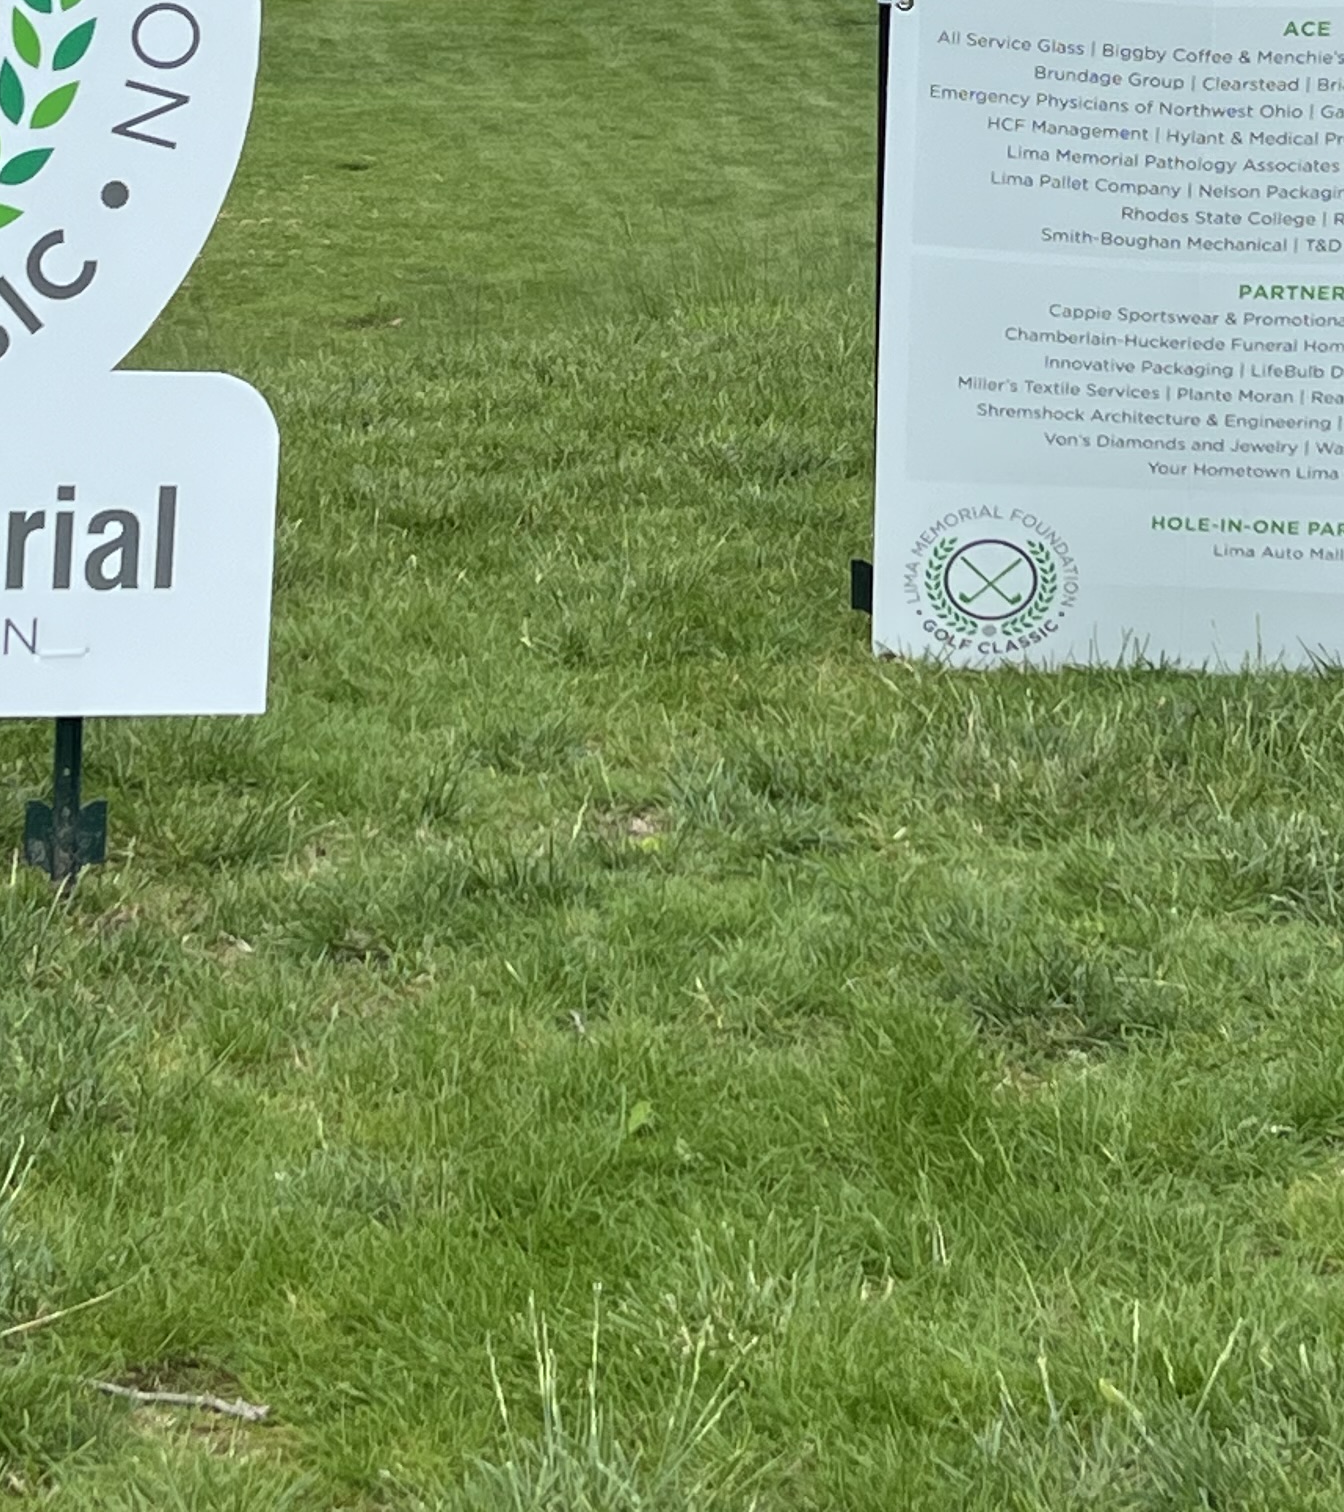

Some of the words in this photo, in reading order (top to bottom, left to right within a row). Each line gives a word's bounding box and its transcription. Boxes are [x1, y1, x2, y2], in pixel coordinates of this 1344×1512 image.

[1282, 20, 1331, 37] ACE
[936, 29, 961, 45] All
[966, 31, 1032, 52] Service
[1036, 38, 1085, 56] Glass
[1101, 42, 1167, 64] Biggby
[1172, 47, 1233, 65] Coffee
[1237, 49, 1252, 65] &
[929, 83, 1031, 109] Emergency
[1035, 91, 1130, 113] Physicians
[1134, 99, 1154, 115] of
[1158, 100, 1254, 119] Northwest
[1258, 103, 1304, 119] Ohio
[1006, 144, 1050, 162] Lima
[1055, 148, 1139, 168] Memorial
[1144, 153, 1238, 175] Pathology
[1242, 157, 1340, 174] Associates
[1120, 205, 1190, 224] Rhodes
[1194, 210, 1243, 226] State
[1246, 210, 1317, 229] College
[1040, 226, 1181, 251] Smith-Boughan
[1186, 235, 1288, 252] Mechanical
[1305, 237, 1343, 253] T&D
[1116, 306, 1220, 326] Sportswear
[1224, 311, 1238, 326] &
[1044, 355, 1136, 374] Innovative
[1140, 359, 1234, 380] Packaging
[1250, 363, 1325, 379] LifeBulb
[1147, 460, 1188, 476] Your
[1192, 462, 1291, 479] Hometown
[1295, 466, 1340, 481] Lima
[1150, 515, 1300, 536] HOLE-IN-ONE
[904, 561, 920, 604] LIMA
[912, 504, 1004, 557] MEMORIAL
[1009, 508, 1079, 608] FOUNDATION
[1212, 543, 1256, 558] Lima
[1261, 545, 1304, 561] Auto
[1309, 547, 1344, 562] Mall
[923, 619, 973, 650] GOLF
[977, 619, 1059, 655] CLASSIC
